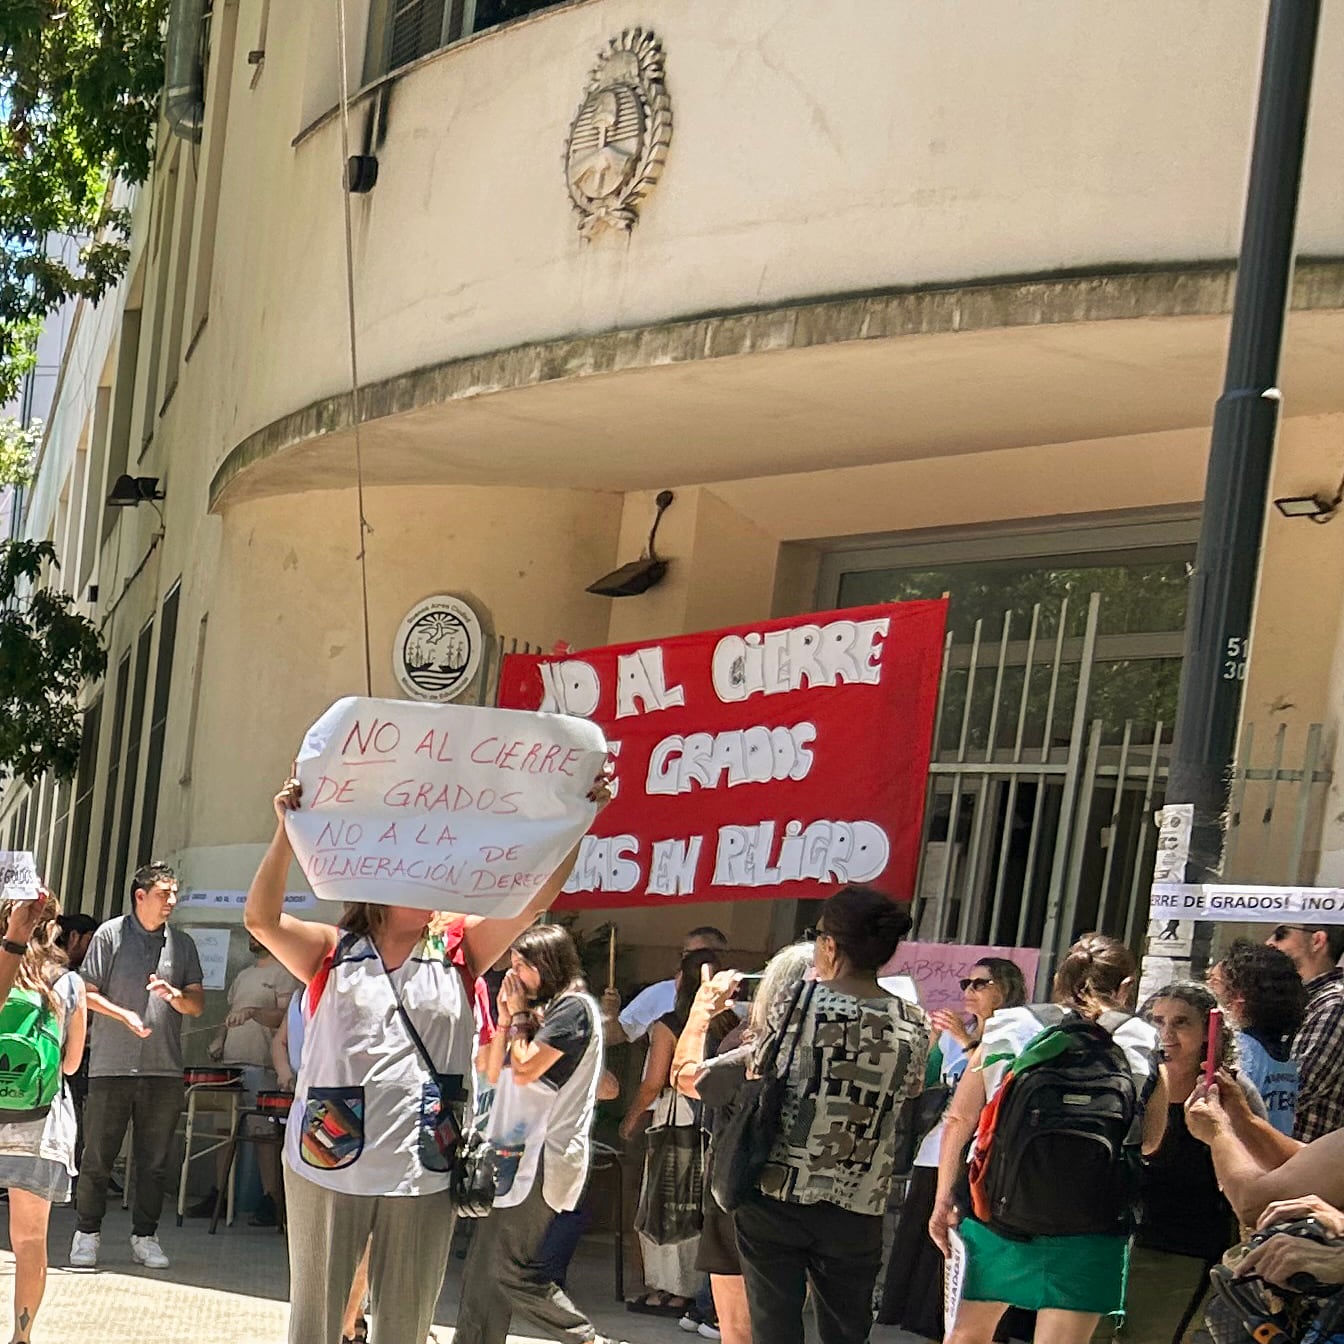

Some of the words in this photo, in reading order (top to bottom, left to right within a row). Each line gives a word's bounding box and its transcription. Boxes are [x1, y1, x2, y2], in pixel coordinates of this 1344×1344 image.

[615, 646, 685, 720] AL
[342, 717, 401, 755] NO
[415, 729, 453, 762] AL
[470, 737, 584, 777] CIERRE
[645, 721, 817, 796] GRADOS
[310, 776, 360, 810] DE
[383, 779, 524, 815] GRADOS
[315, 820, 362, 847] NO
[378, 821, 398, 845] A
[415, 824, 458, 846] LA
[479, 845, 525, 863] DE
[645, 835, 703, 895] EN
[1183, 895, 1205, 909] DE
[1210, 895, 1289, 909] GRADOS!
[1301, 896, 1335, 911] ¡NO
